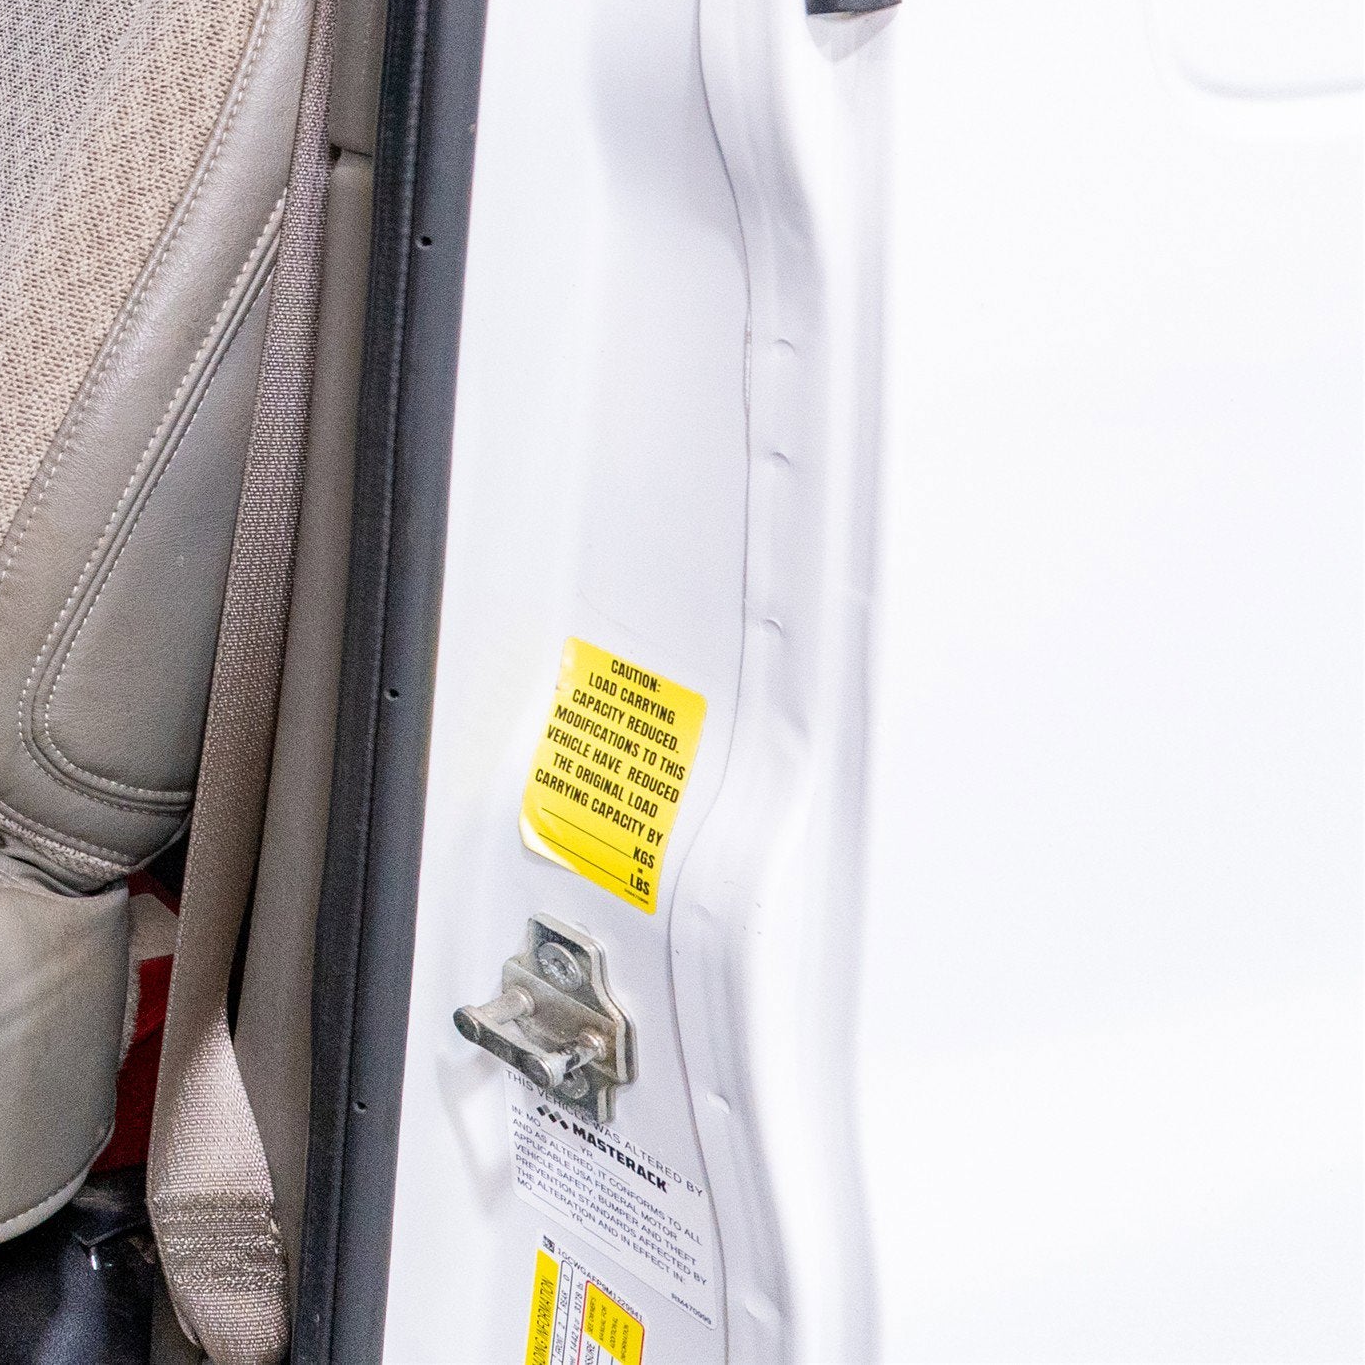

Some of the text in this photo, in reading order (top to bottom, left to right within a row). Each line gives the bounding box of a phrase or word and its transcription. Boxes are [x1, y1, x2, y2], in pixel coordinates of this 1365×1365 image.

[588, 672, 676, 725] LOAD CARRYING
[610, 658, 662, 694] CAUTION:
[554, 703, 686, 781] MODIFICATIONS TO THIS
[571, 687, 681, 753] CAPACITY REDUCED.
[546, 724, 680, 804] VEHICLE HAVE REDUCED
[552, 751, 658, 819] THE ORIGINAL LOAD
[534, 767, 663, 847] CARRYING CAPACITY BY
[628, 873, 651, 895] LBS
[632, 845, 656, 869] KGS
[506, 1068, 533, 1092] THIS
[594, 1120, 620, 1145] WAS
[624, 1139, 682, 1185] ALTERED
[686, 1179, 703, 1199] BY
[572, 1122, 666, 1193] MASTERACK
[512, 1116, 532, 1134] AND
[534, 1130, 546, 1144] AS
[598, 1169, 606, 1181] IT
[609, 1176, 665, 1221] CONFORMS
[667, 1215, 681, 1232] TO
[684, 1227, 702, 1246] ALL
[513, 1129, 677, 1242] APPLICABLE USA FEDERAL MOTOR
[515, 1141, 553, 1172] VEHICLE
[598, 1194, 638, 1228] BUMPER
[641, 1223, 661, 1243] AND
[665, 1239, 696, 1267] THEFT
[515, 1153, 707, 1287] PREVENTION STANDARDS AFFECTED BY
[516, 1166, 535, 1183] THE
[537, 1178, 595, 1223] ALTERATION
[597, 1218, 618, 1239] AND
[620, 1233, 630, 1246] IN
[632, 1241, 669, 1274] EFFECT
[535, 1276, 554, 1336] INFORMATION
